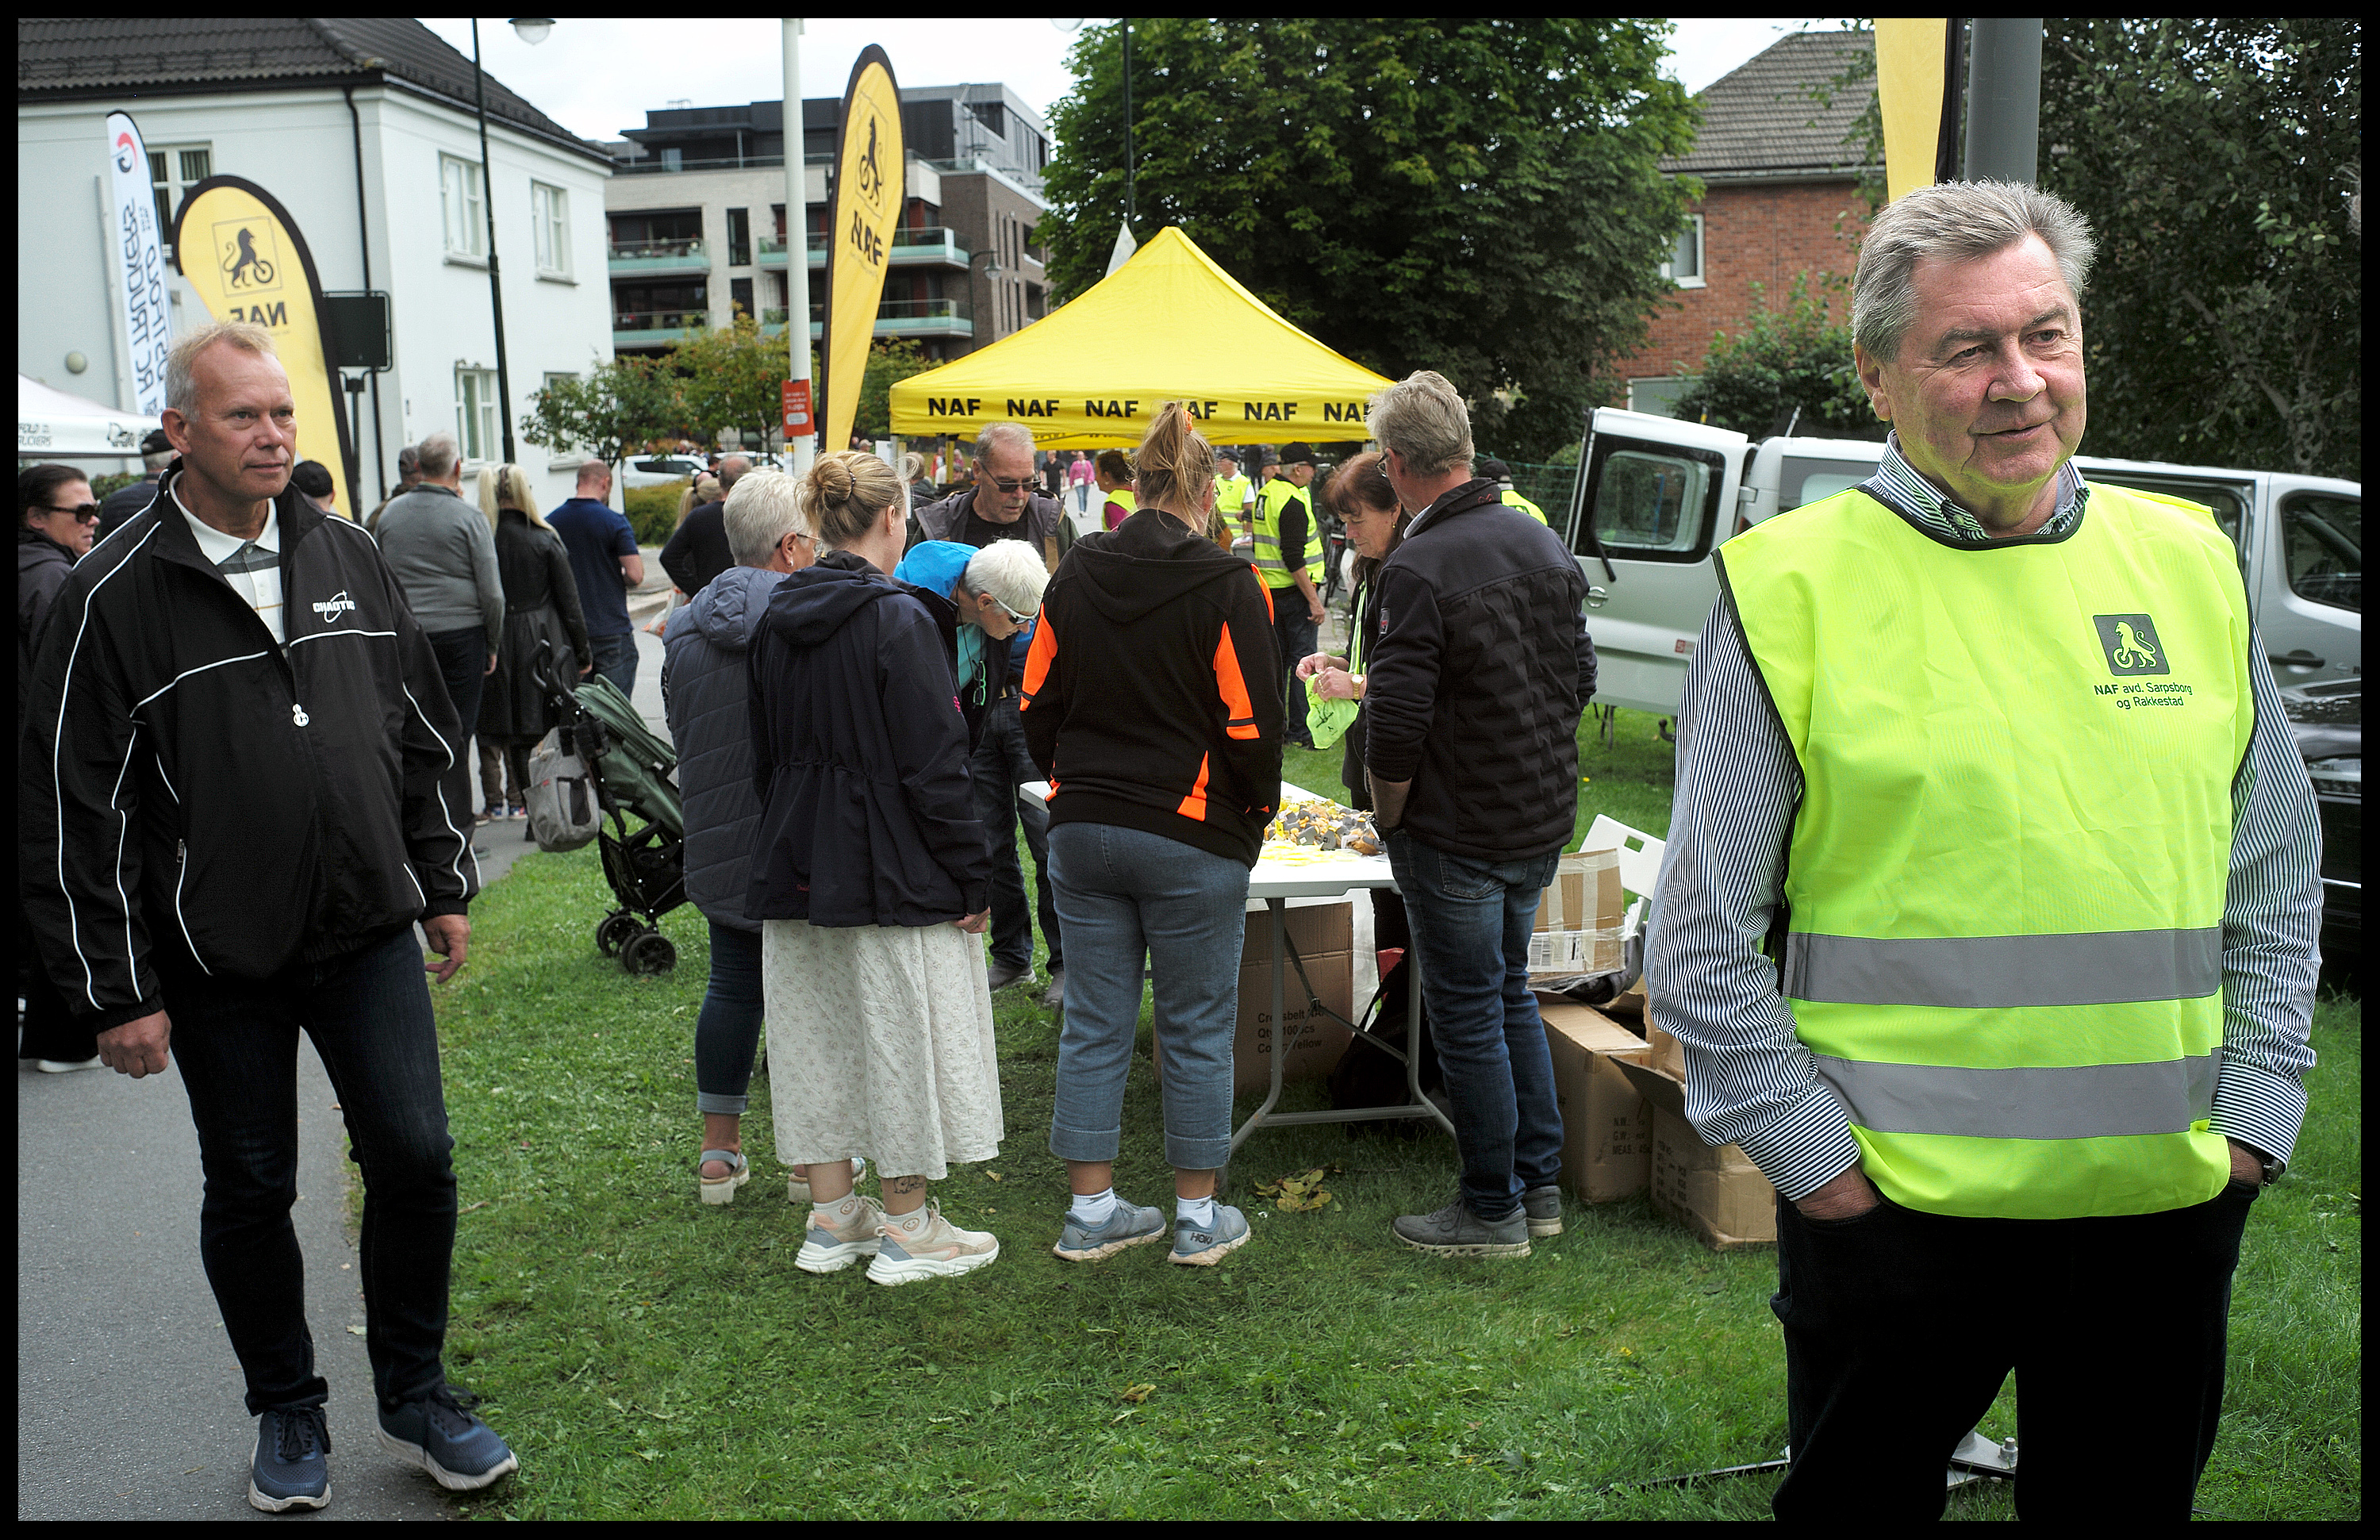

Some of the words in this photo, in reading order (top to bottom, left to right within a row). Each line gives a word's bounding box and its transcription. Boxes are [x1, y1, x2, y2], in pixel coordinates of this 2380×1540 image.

[851, 209, 882, 266] NAF
[928, 398, 981, 417] NAF
[1007, 399, 1059, 417] NAF
[1085, 400, 1138, 417] NAF
[1181, 401, 1218, 420] AF
[1245, 402, 1297, 421] NAF
[312, 600, 355, 613] CHAOTIC
[2094, 684, 2119, 695] NAF
[2122, 683, 2144, 693] avd.
[2146, 682, 2193, 695] Sarpsborg
[2117, 700, 2131, 709] og
[2132, 696, 2184, 707] Rakkestad
[1257, 1009, 1305, 1023] Crsbelt
